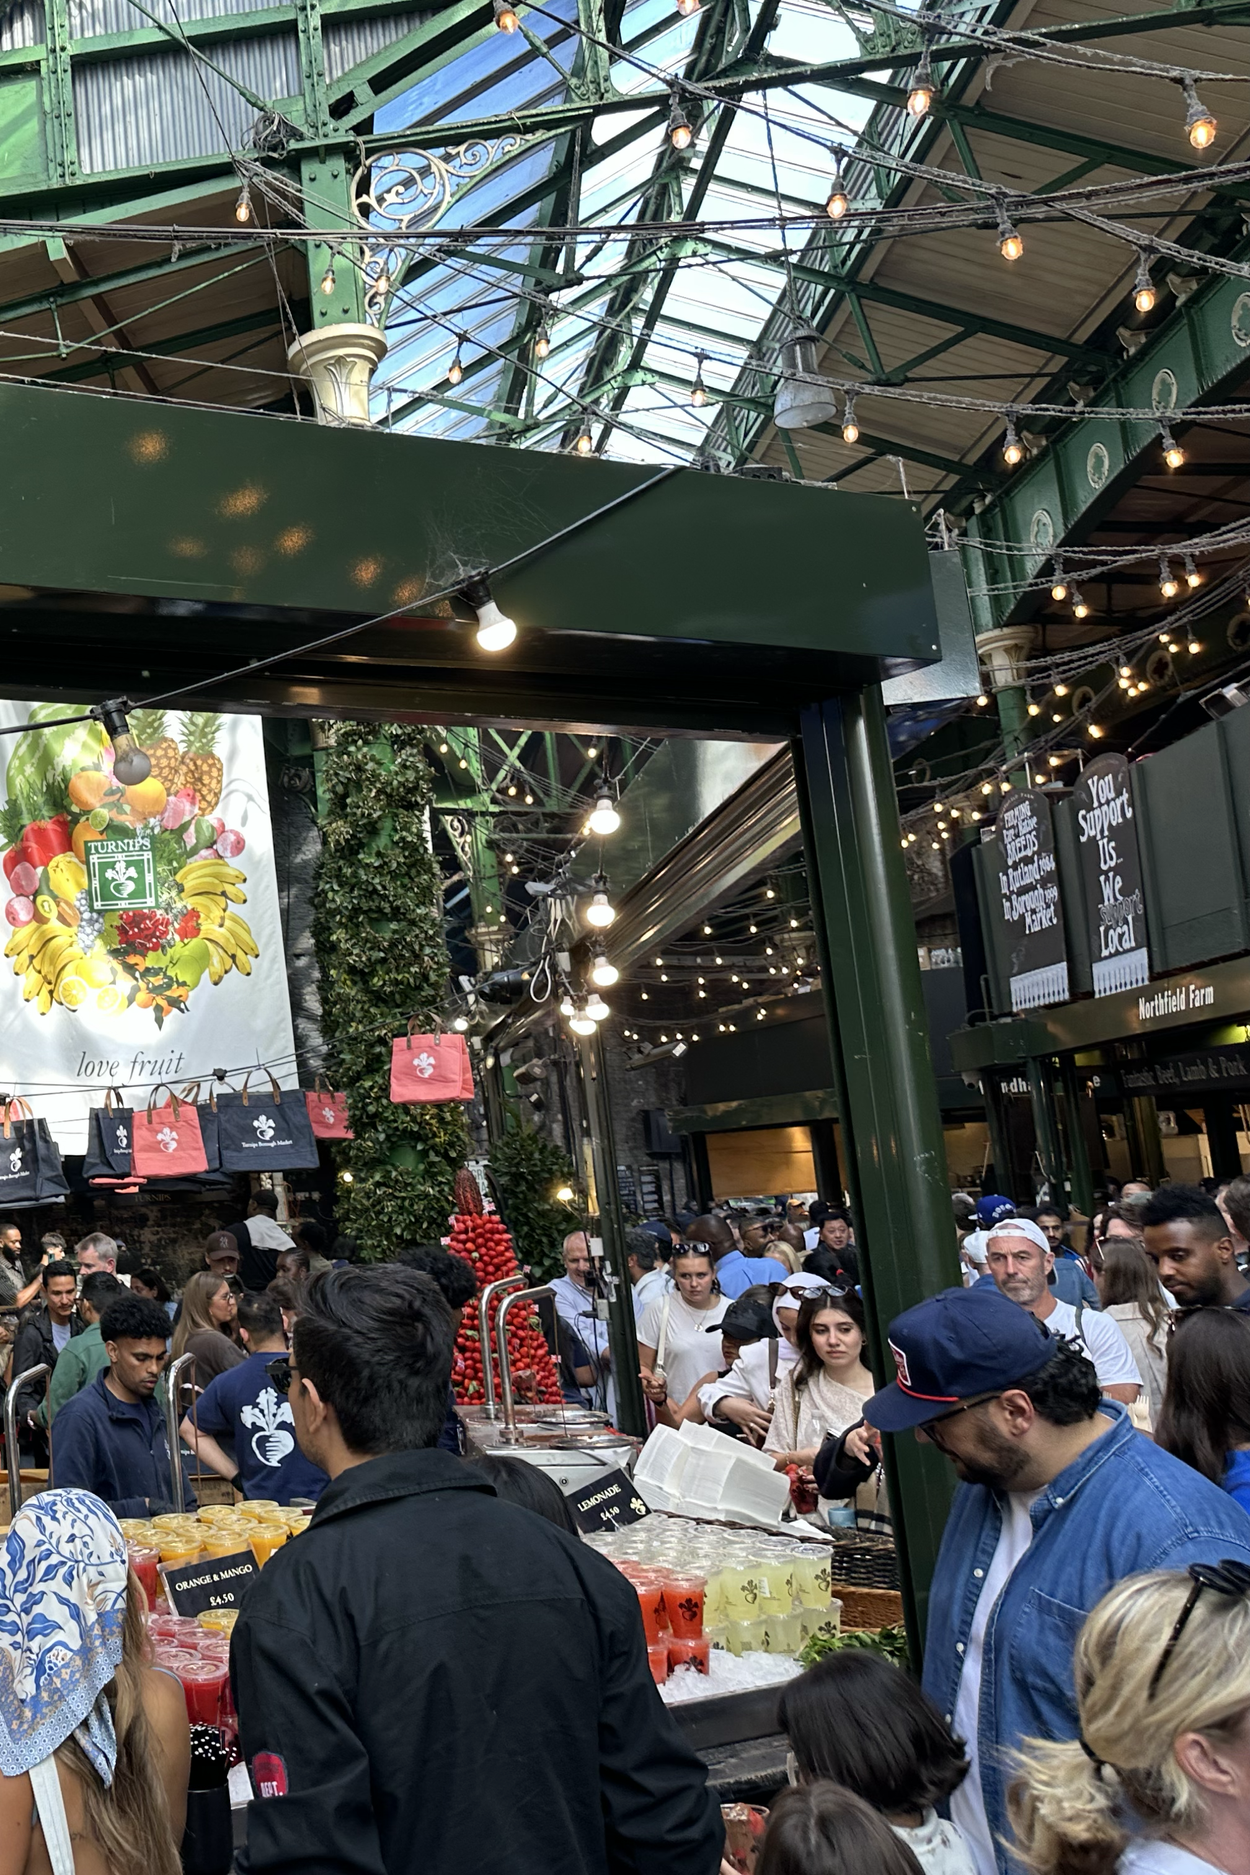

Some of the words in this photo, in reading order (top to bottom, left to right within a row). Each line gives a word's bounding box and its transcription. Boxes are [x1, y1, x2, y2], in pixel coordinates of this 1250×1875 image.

[1087, 773, 1115, 808] You
[1004, 801, 1031, 828] FARMING
[1019, 815, 1038, 836] Native
[1078, 788, 1133, 843] Support
[88, 838, 151, 853] TURNIPS
[1006, 831, 1038, 866] BREEDS
[999, 872, 1010, 895] In
[1008, 854, 1040, 892] Rutland
[1099, 871, 1123, 907] We
[1002, 898, 1012, 922] In
[1012, 884, 1046, 920] Borough
[1025, 903, 1058, 935] Market
[1100, 914, 1136, 957] Local
[1138, 986, 1186, 1020] Northfield
[1189, 984, 1214, 1009] Farm
[76, 1051, 120, 1077] love
[128, 1050, 185, 1083] fruit
[1178, 1059, 1207, 1081] Lamb
[1207, 1058, 1220, 1078] &
[1219, 1054, 1248, 1077] Pork
[577, 1483, 621, 1512] LEMONADE
[175, 1574, 212, 1592] ORANGE
[213, 1572, 220, 1582] &
[220, 1564, 253, 1580] MANGO
[210, 1592, 235, 1606] £4.50
